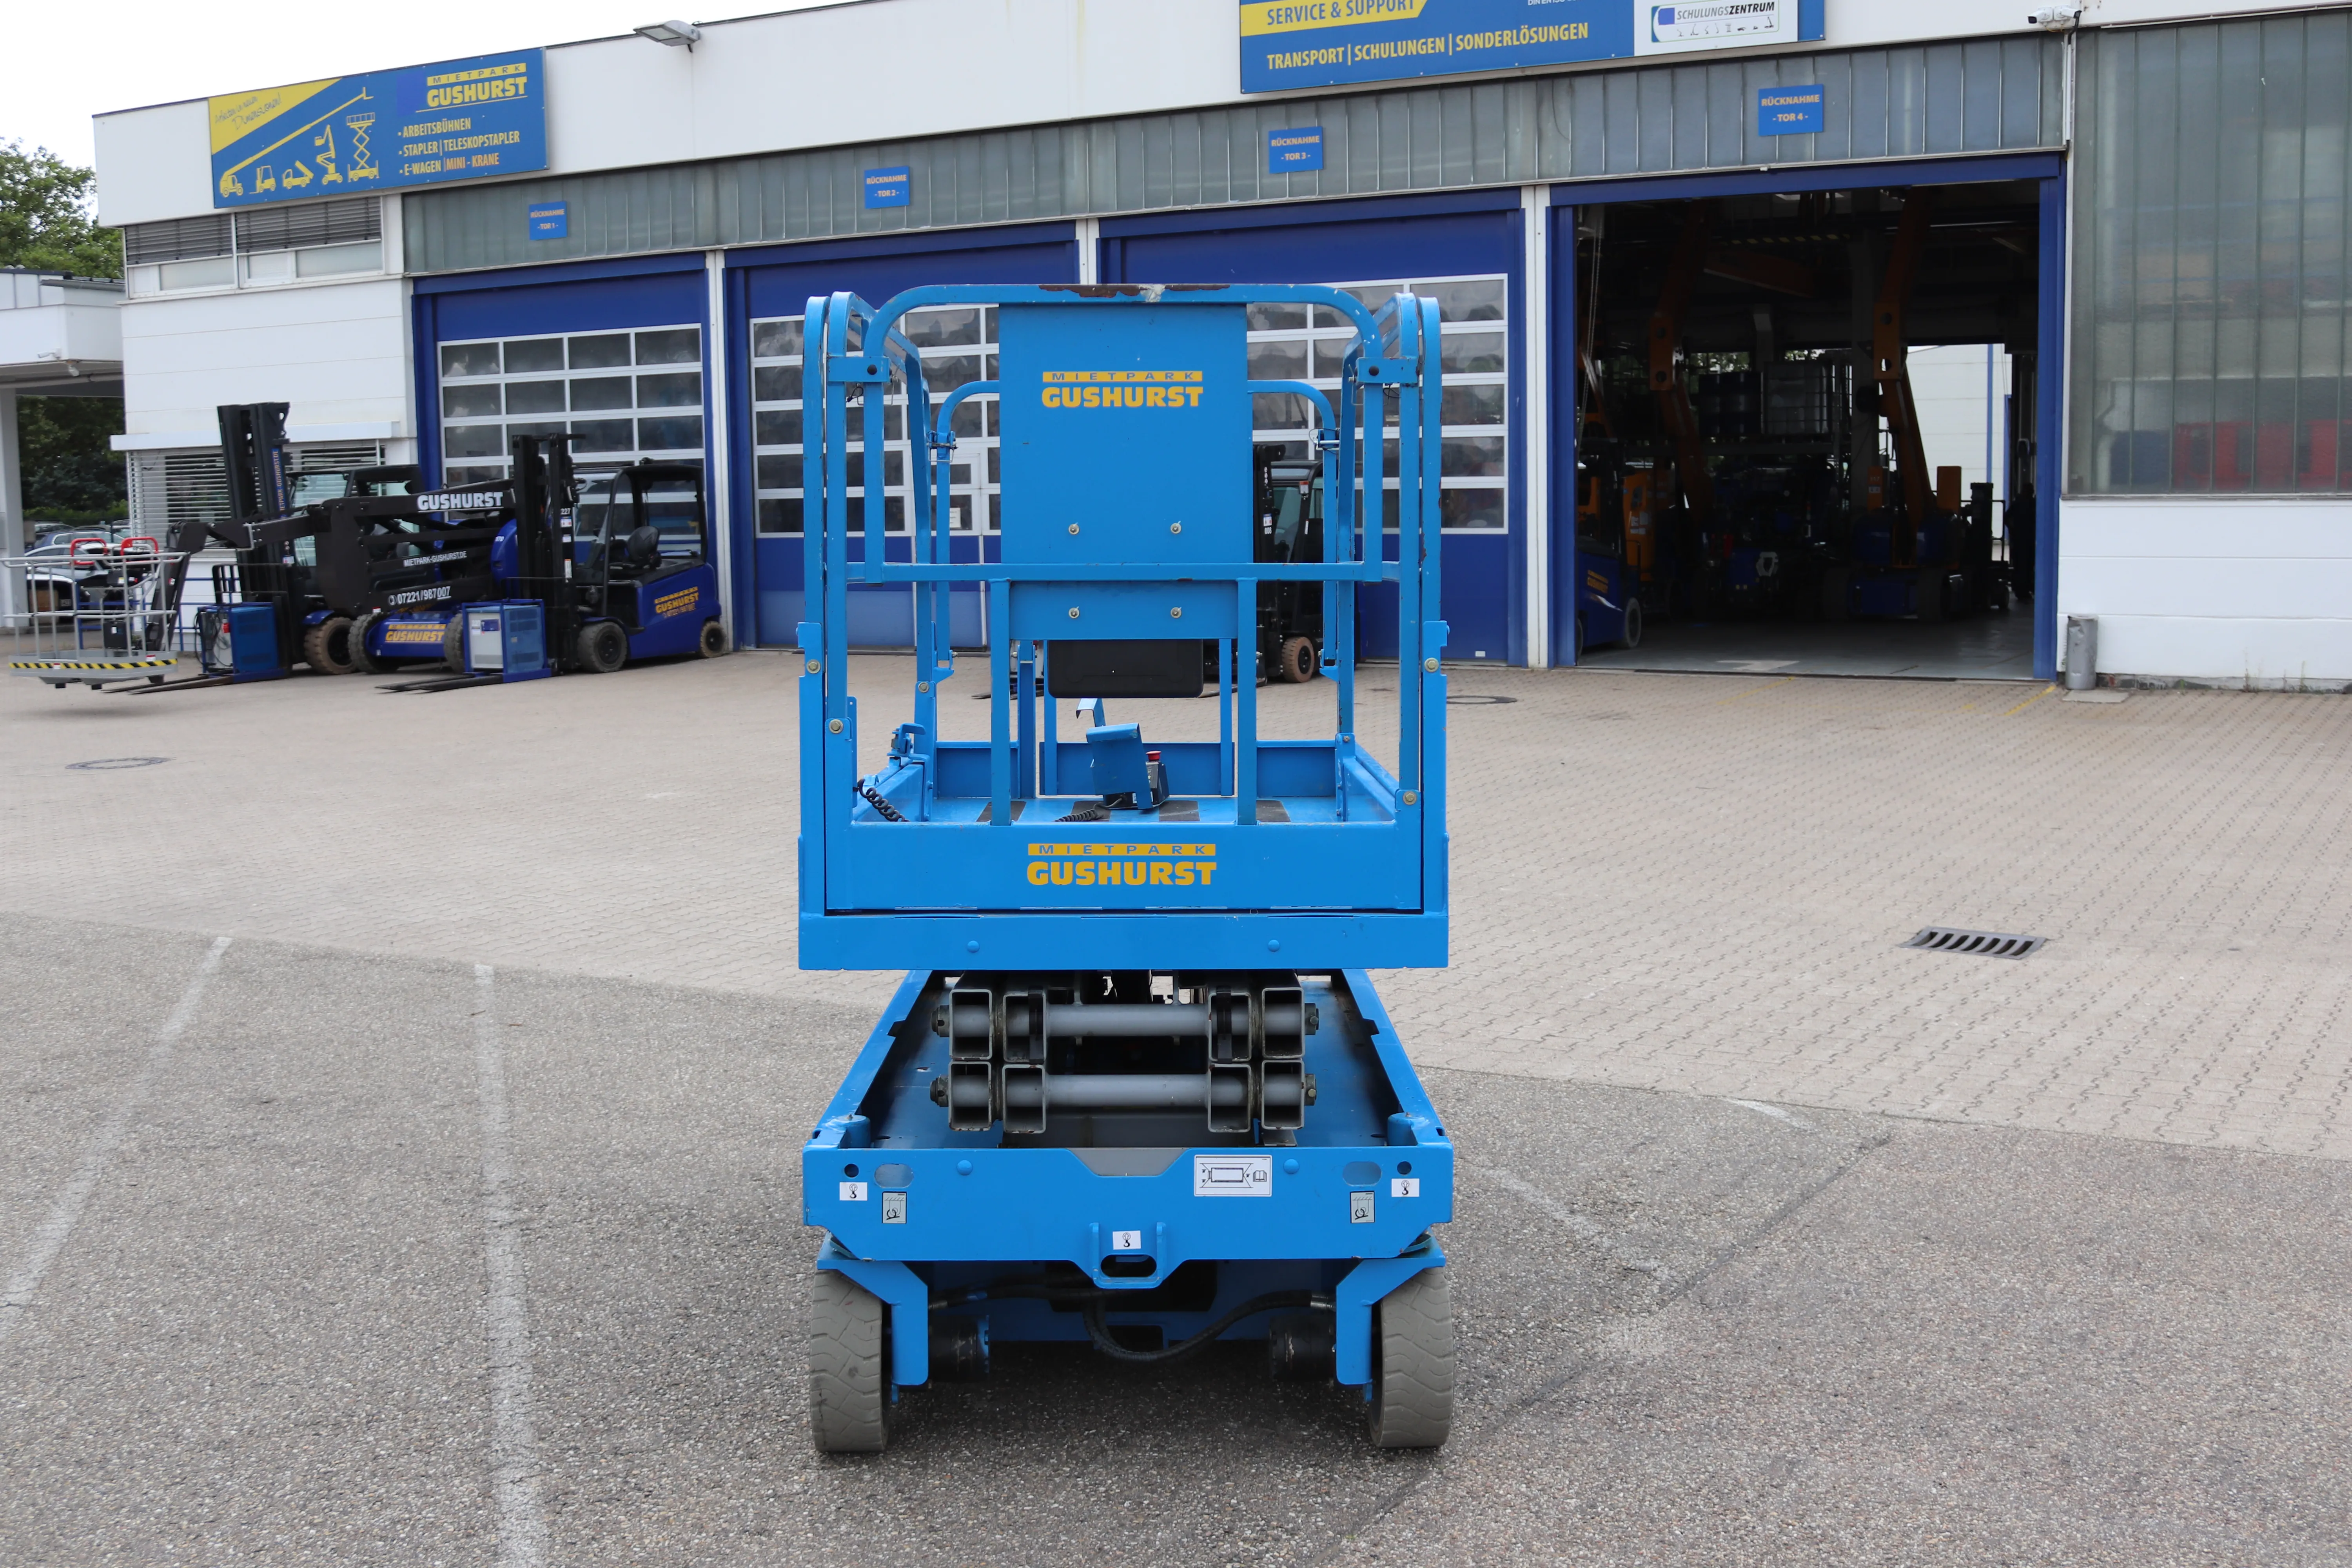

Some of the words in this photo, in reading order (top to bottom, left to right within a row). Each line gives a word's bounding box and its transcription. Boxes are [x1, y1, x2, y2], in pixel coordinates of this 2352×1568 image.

[1267, 3, 1326, 25] SERVICE
[1330, 2, 1341, 18] &
[1677, 2, 1775, 20] SCHULUNGSZENTRUM
[1267, 47, 1345, 70] TRANSPORT
[1354, 37, 1445, 61] SCHULUNGEN
[1455, 22, 1588, 51] SONDERLÖSUNGEN
[433, 65, 521, 83] MIETPARK
[427, 76, 528, 107] GUSHURST
[1761, 94, 1820, 107] RÜCKNAHME
[1777, 113, 1796, 122] TOR
[403, 118, 471, 138] ARBEITSBÜHNEN
[404, 141, 439, 157] STAPLER
[444, 131, 520, 152] TELESKOPSTAPLER
[1271, 135, 1320, 147] RÜCKNAHME
[404, 160, 441, 176] E-WAGEN
[472, 152, 499, 168] KRANE
[1285, 152, 1300, 161] TOR
[1052, 372, 1194, 381] MIETPARK
[1042, 386, 1203, 408] GUSHURST
[417, 492, 503, 510] GUSHURST
[397, 586, 451, 604] 07221/987007
[655, 592, 699, 613] GUSHURST
[385, 631, 445, 641] GUSHURST
[1038, 845, 1205, 854] MIETPARK
[1027, 861, 1217, 886] GUSHURST
